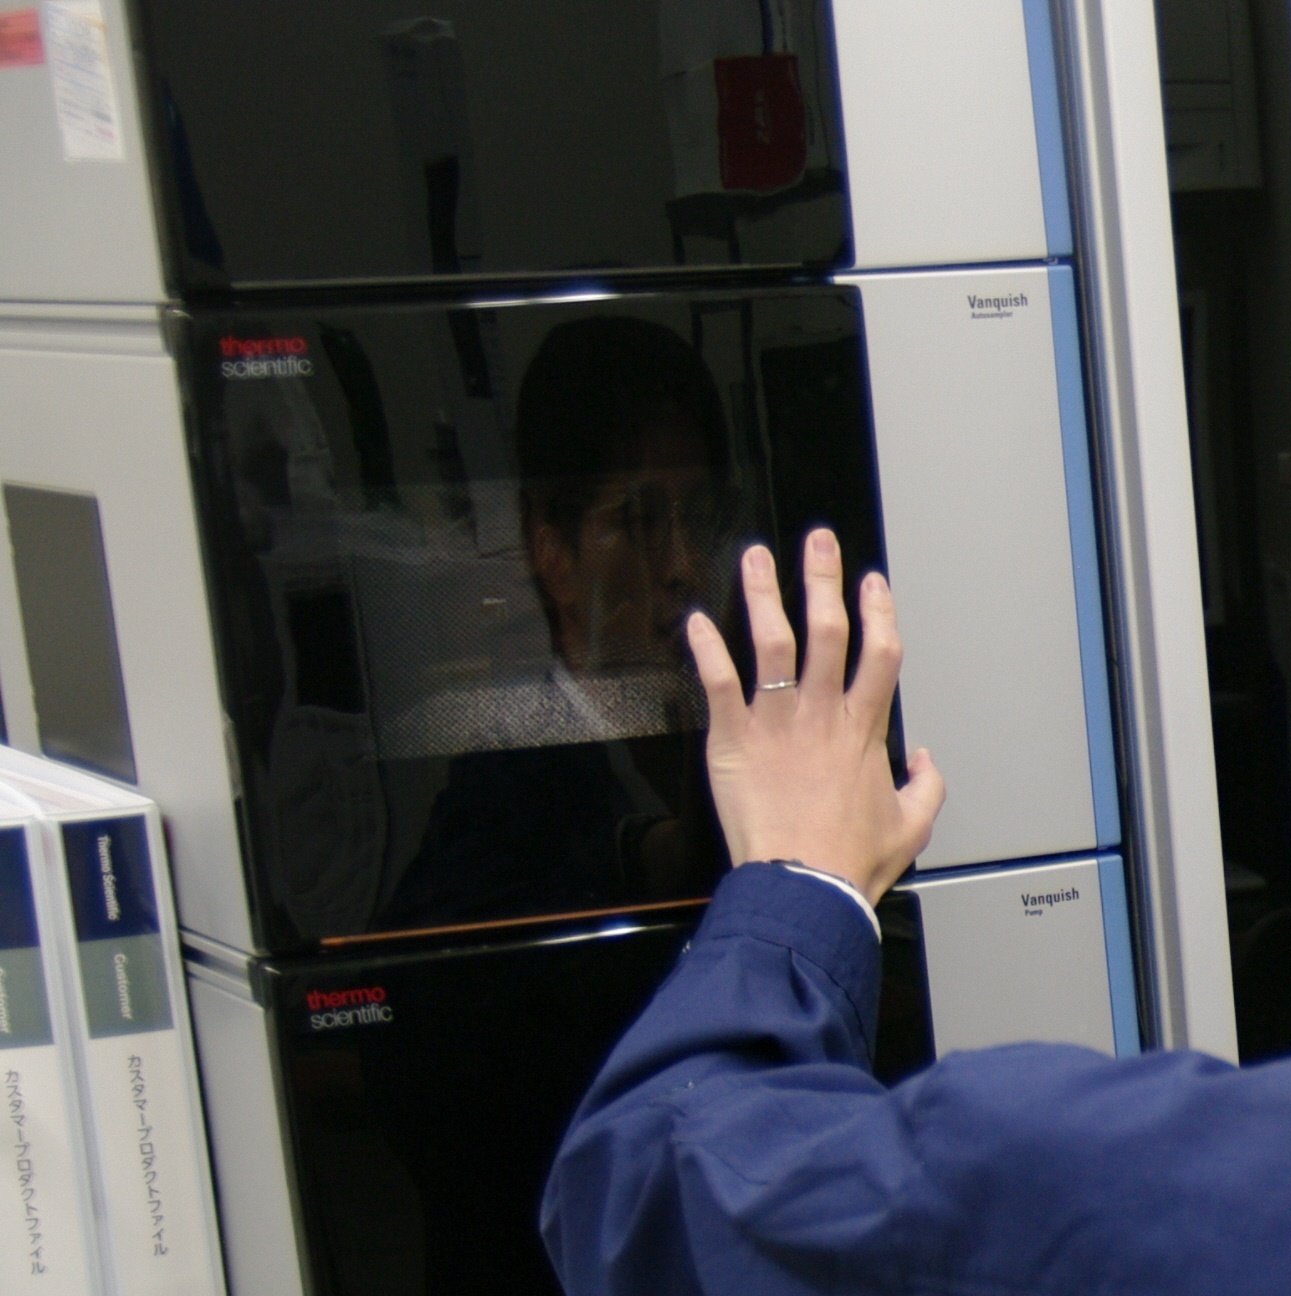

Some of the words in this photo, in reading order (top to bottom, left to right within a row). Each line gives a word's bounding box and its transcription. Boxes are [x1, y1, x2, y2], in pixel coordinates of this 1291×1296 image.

[967, 292, 1028, 312] Vanquish
[219, 335, 306, 356] thermo
[221, 354, 314, 378] scientific
[97, 833, 112, 874] Thermo
[102, 874, 121, 922] Scientific
[1021, 887, 1080, 908] Vanquish
[114, 952, 135, 1020] Customer
[306, 985, 387, 1010] thermo
[310, 1002, 394, 1031] scientific
